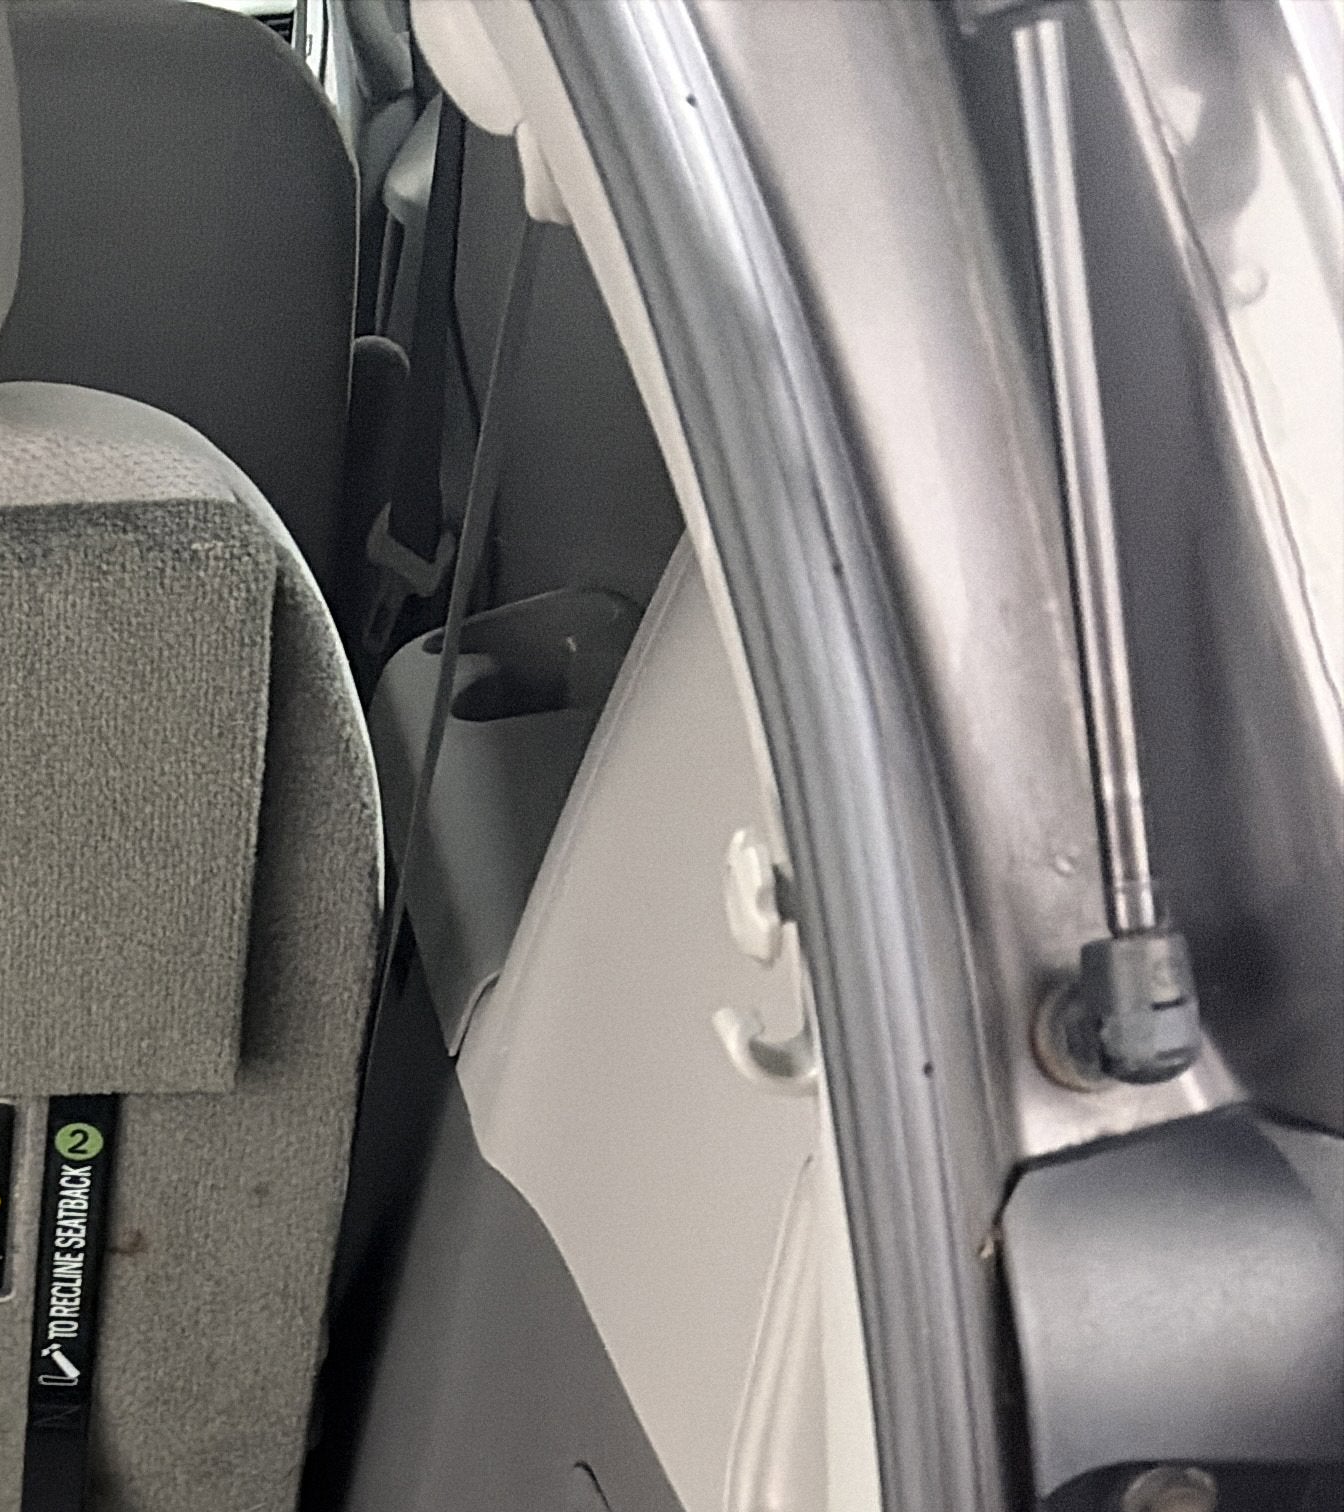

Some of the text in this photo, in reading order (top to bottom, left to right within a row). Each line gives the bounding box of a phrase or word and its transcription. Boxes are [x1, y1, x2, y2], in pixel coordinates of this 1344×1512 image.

[67, 1129, 89, 1154] 2
[47, 1163, 93, 1340] TO RECLINE SEATBACK
